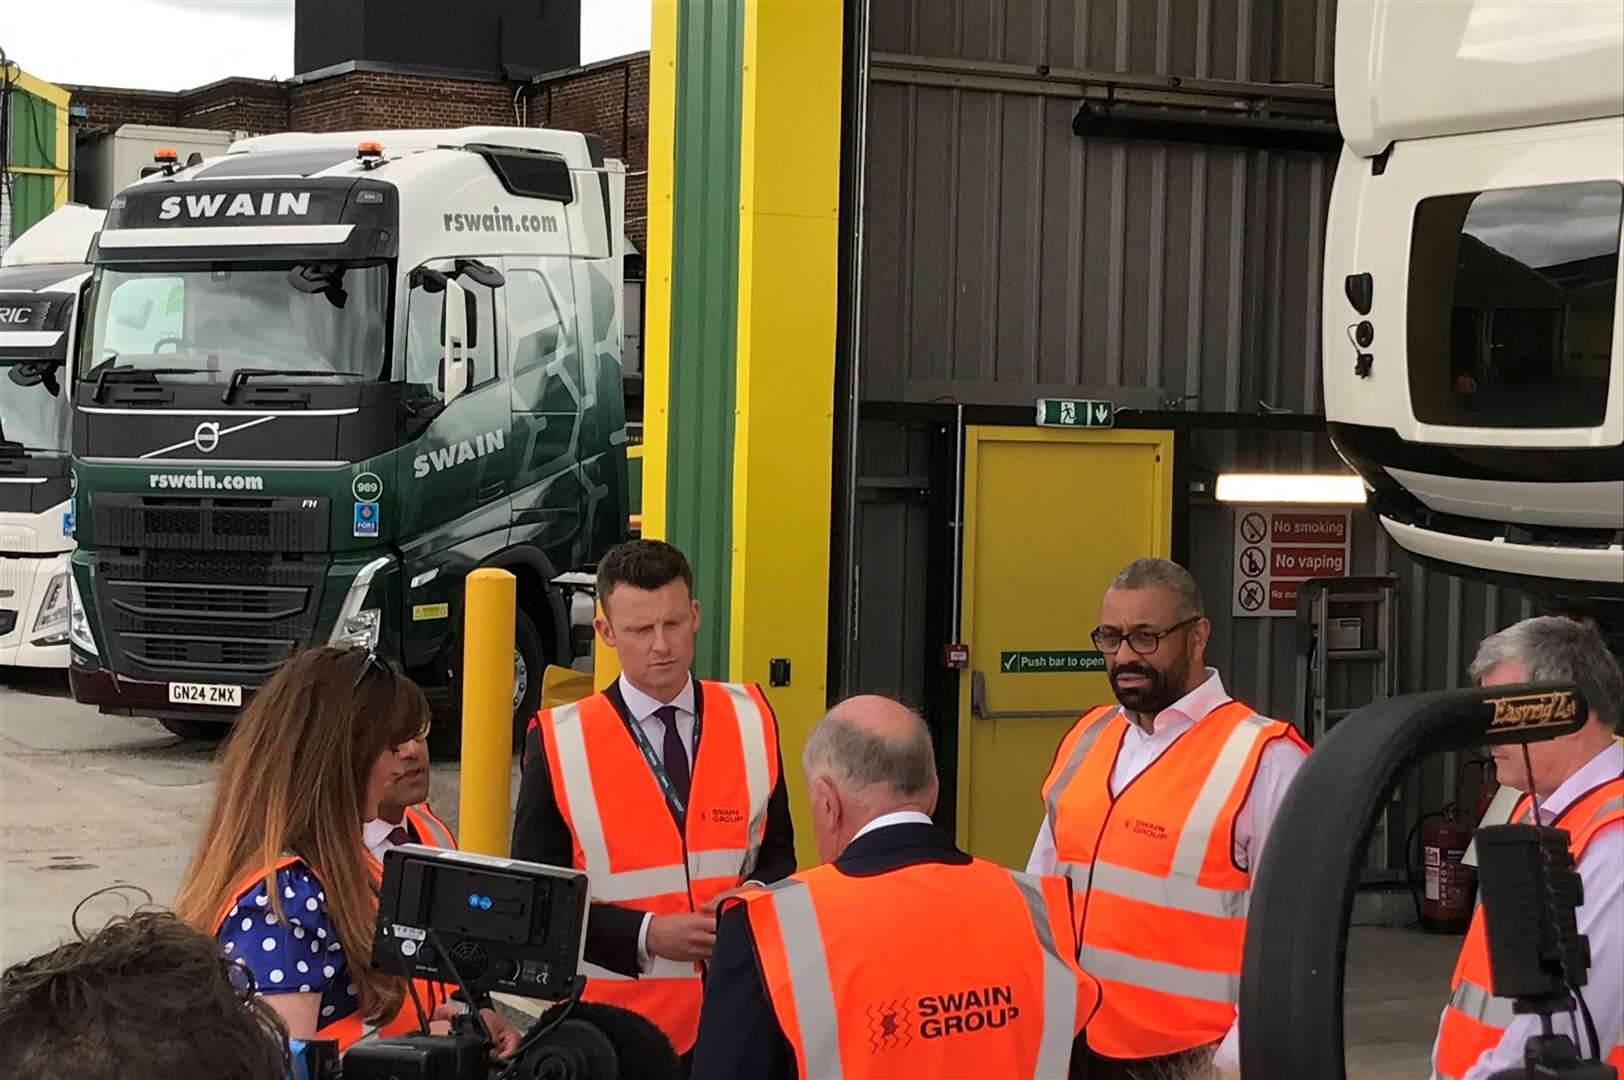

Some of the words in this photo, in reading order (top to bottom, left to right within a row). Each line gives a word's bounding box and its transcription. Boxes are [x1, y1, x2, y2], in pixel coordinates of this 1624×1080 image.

[158, 192, 311, 220] SWAIN
[443, 205, 558, 233] rswain.com
[413, 428, 505, 478] SWAIN
[149, 469, 264, 490] rswain.com
[302, 499, 318, 509] FH
[1273, 520, 1292, 534] No
[1294, 520, 1344, 537] smoking
[1275, 553, 1295, 568] No
[1298, 553, 1343, 572] vaping
[1020, 656, 1046, 667] Push
[1048, 656, 1066, 667] bar
[1067, 656, 1078, 667] to
[1079, 657, 1105, 670] open
[173, 685, 206, 701] GN24
[209, 687, 235, 702] ZMX
[917, 985, 1013, 1018] SWAIN
[919, 1006, 1020, 1040] GROUP
